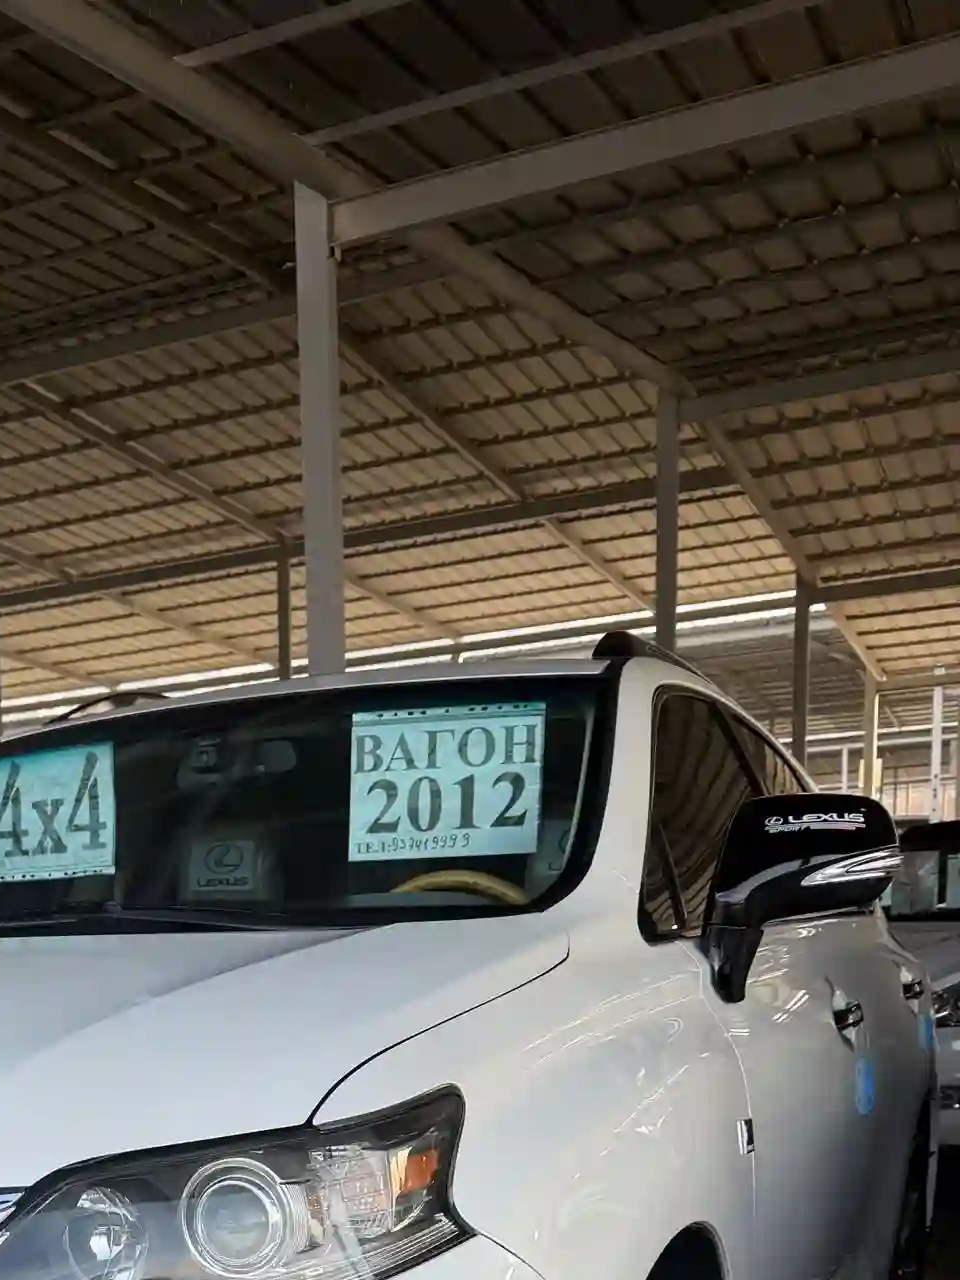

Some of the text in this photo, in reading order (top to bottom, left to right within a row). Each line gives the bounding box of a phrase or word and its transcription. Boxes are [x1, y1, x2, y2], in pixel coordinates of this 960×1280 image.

[354, 723, 539, 774] ВАГОН
[365, 771, 529, 834] 2012
[788, 812, 865, 823] LEXUS
[197, 876, 250, 888] LEXUS
